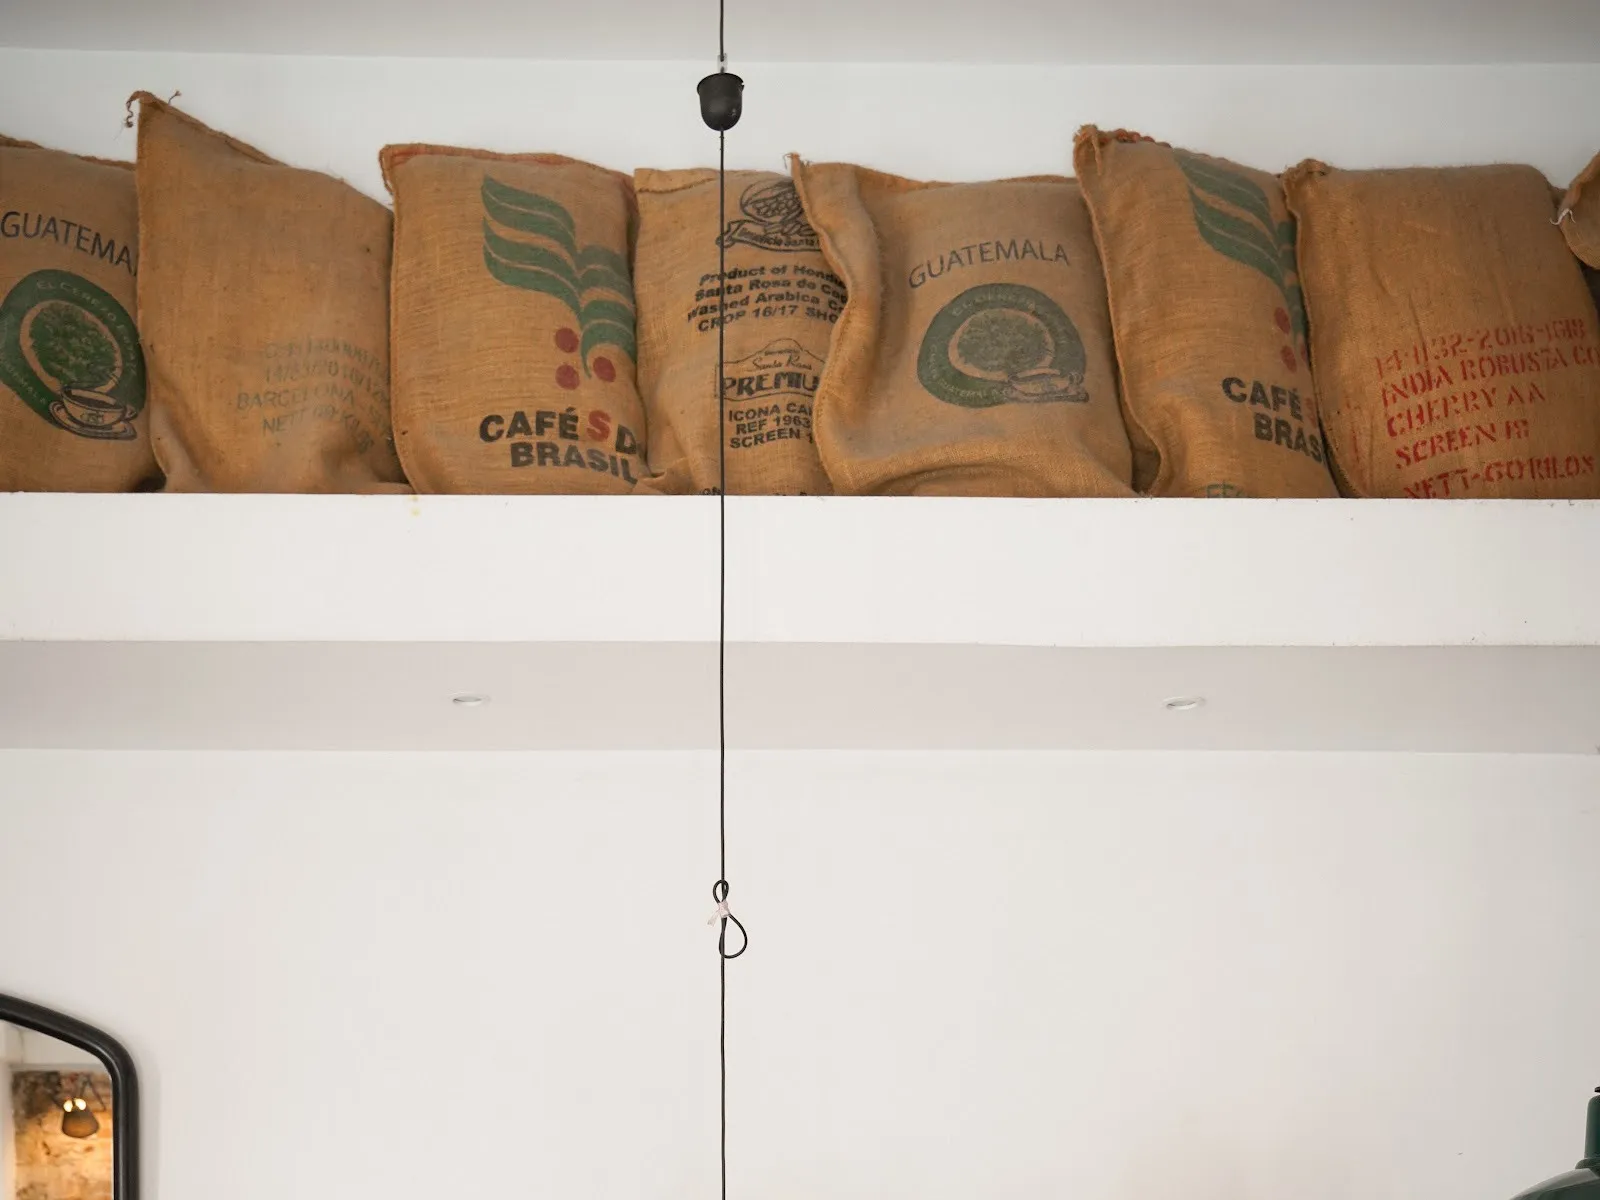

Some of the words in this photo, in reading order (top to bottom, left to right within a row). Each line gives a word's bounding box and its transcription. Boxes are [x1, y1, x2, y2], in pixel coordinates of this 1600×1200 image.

[1, 211, 138, 277] GUATEMA
[770, 264, 787, 275] of
[908, 239, 1071, 288] GUATEMALA
[749, 279, 791, 290] Rosa
[1381, 364, 1454, 408] INDIA
[1460, 348, 1568, 381] ROBUSTA
[729, 403, 781, 422] ICONA
[735, 418, 768, 436] REF
[615, 423, 642, 455] D
[729, 427, 800, 449] SCREEN
[1395, 423, 1497, 470] SCREEN
[510, 442, 639, 485] BRASIL
